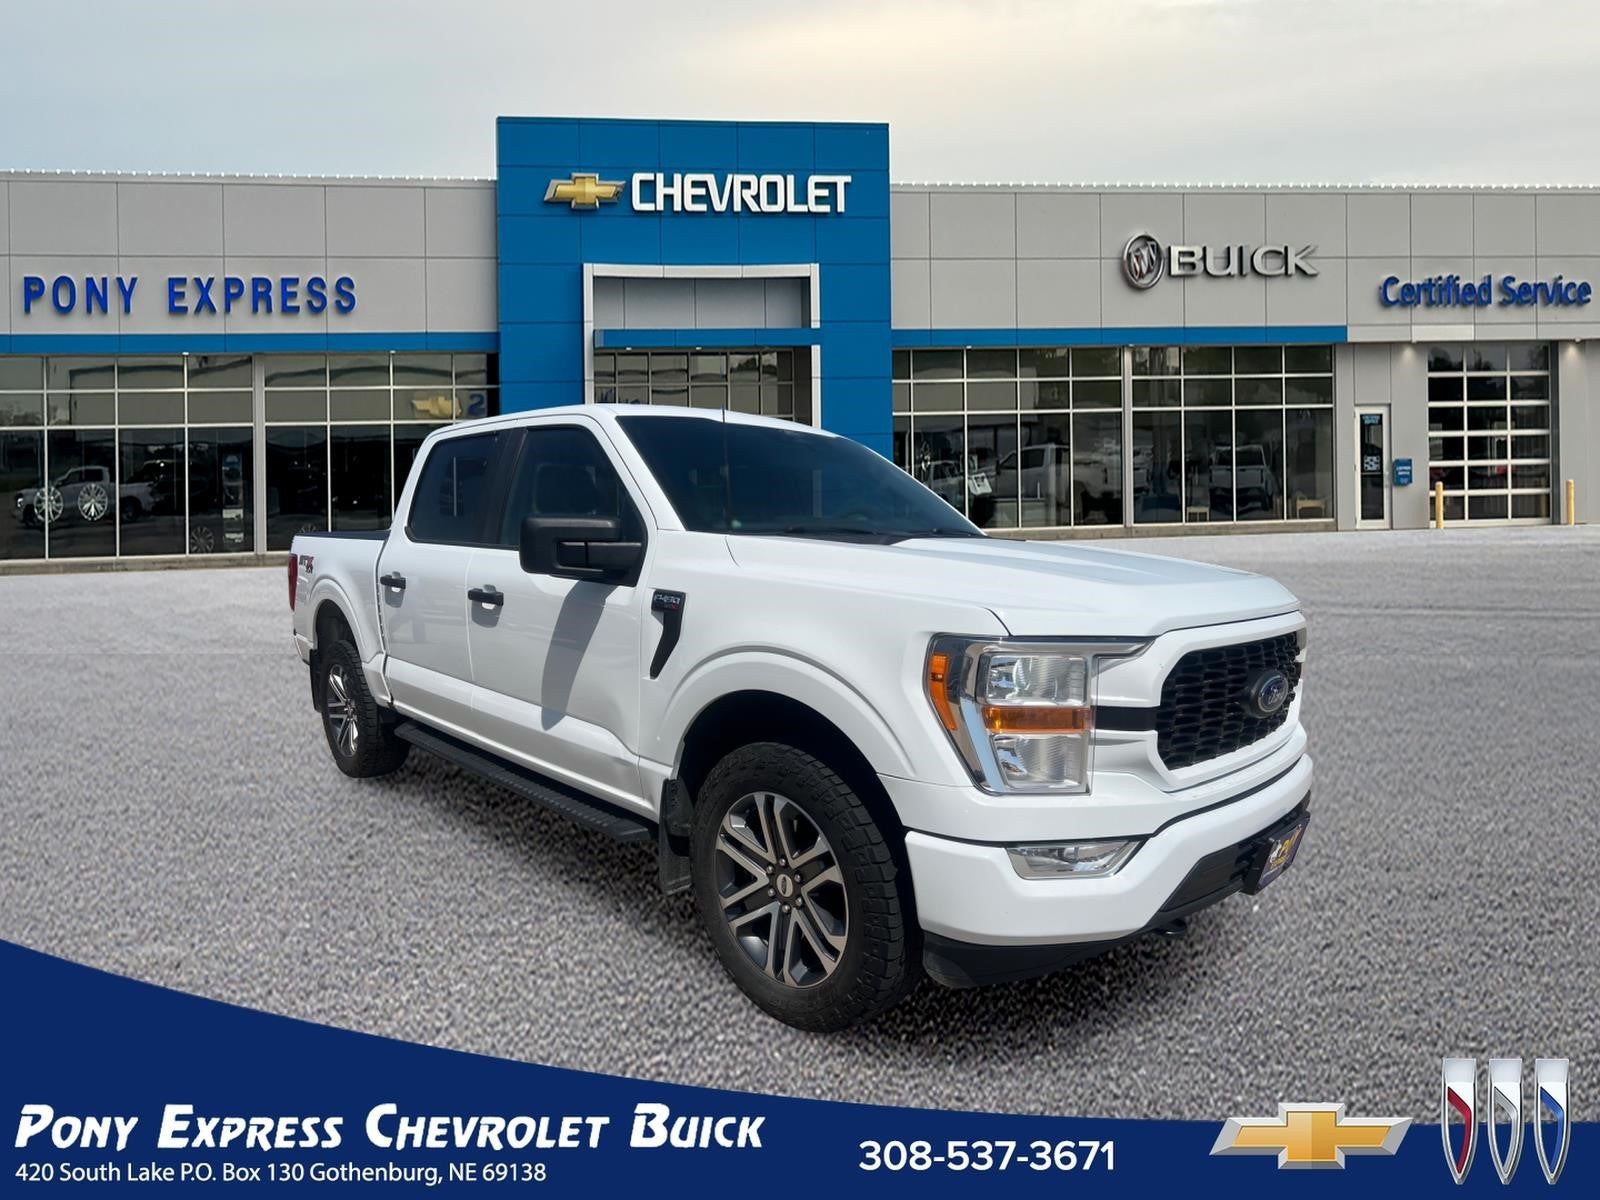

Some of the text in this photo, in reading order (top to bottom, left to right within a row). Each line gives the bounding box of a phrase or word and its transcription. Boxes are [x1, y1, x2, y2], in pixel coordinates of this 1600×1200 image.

[631, 172, 852, 213] CHEVROLET
[1169, 244, 1319, 276] BUICK
[23, 275, 357, 315] PONY EXPRESS
[1380, 274, 1592, 307] Certified Service
